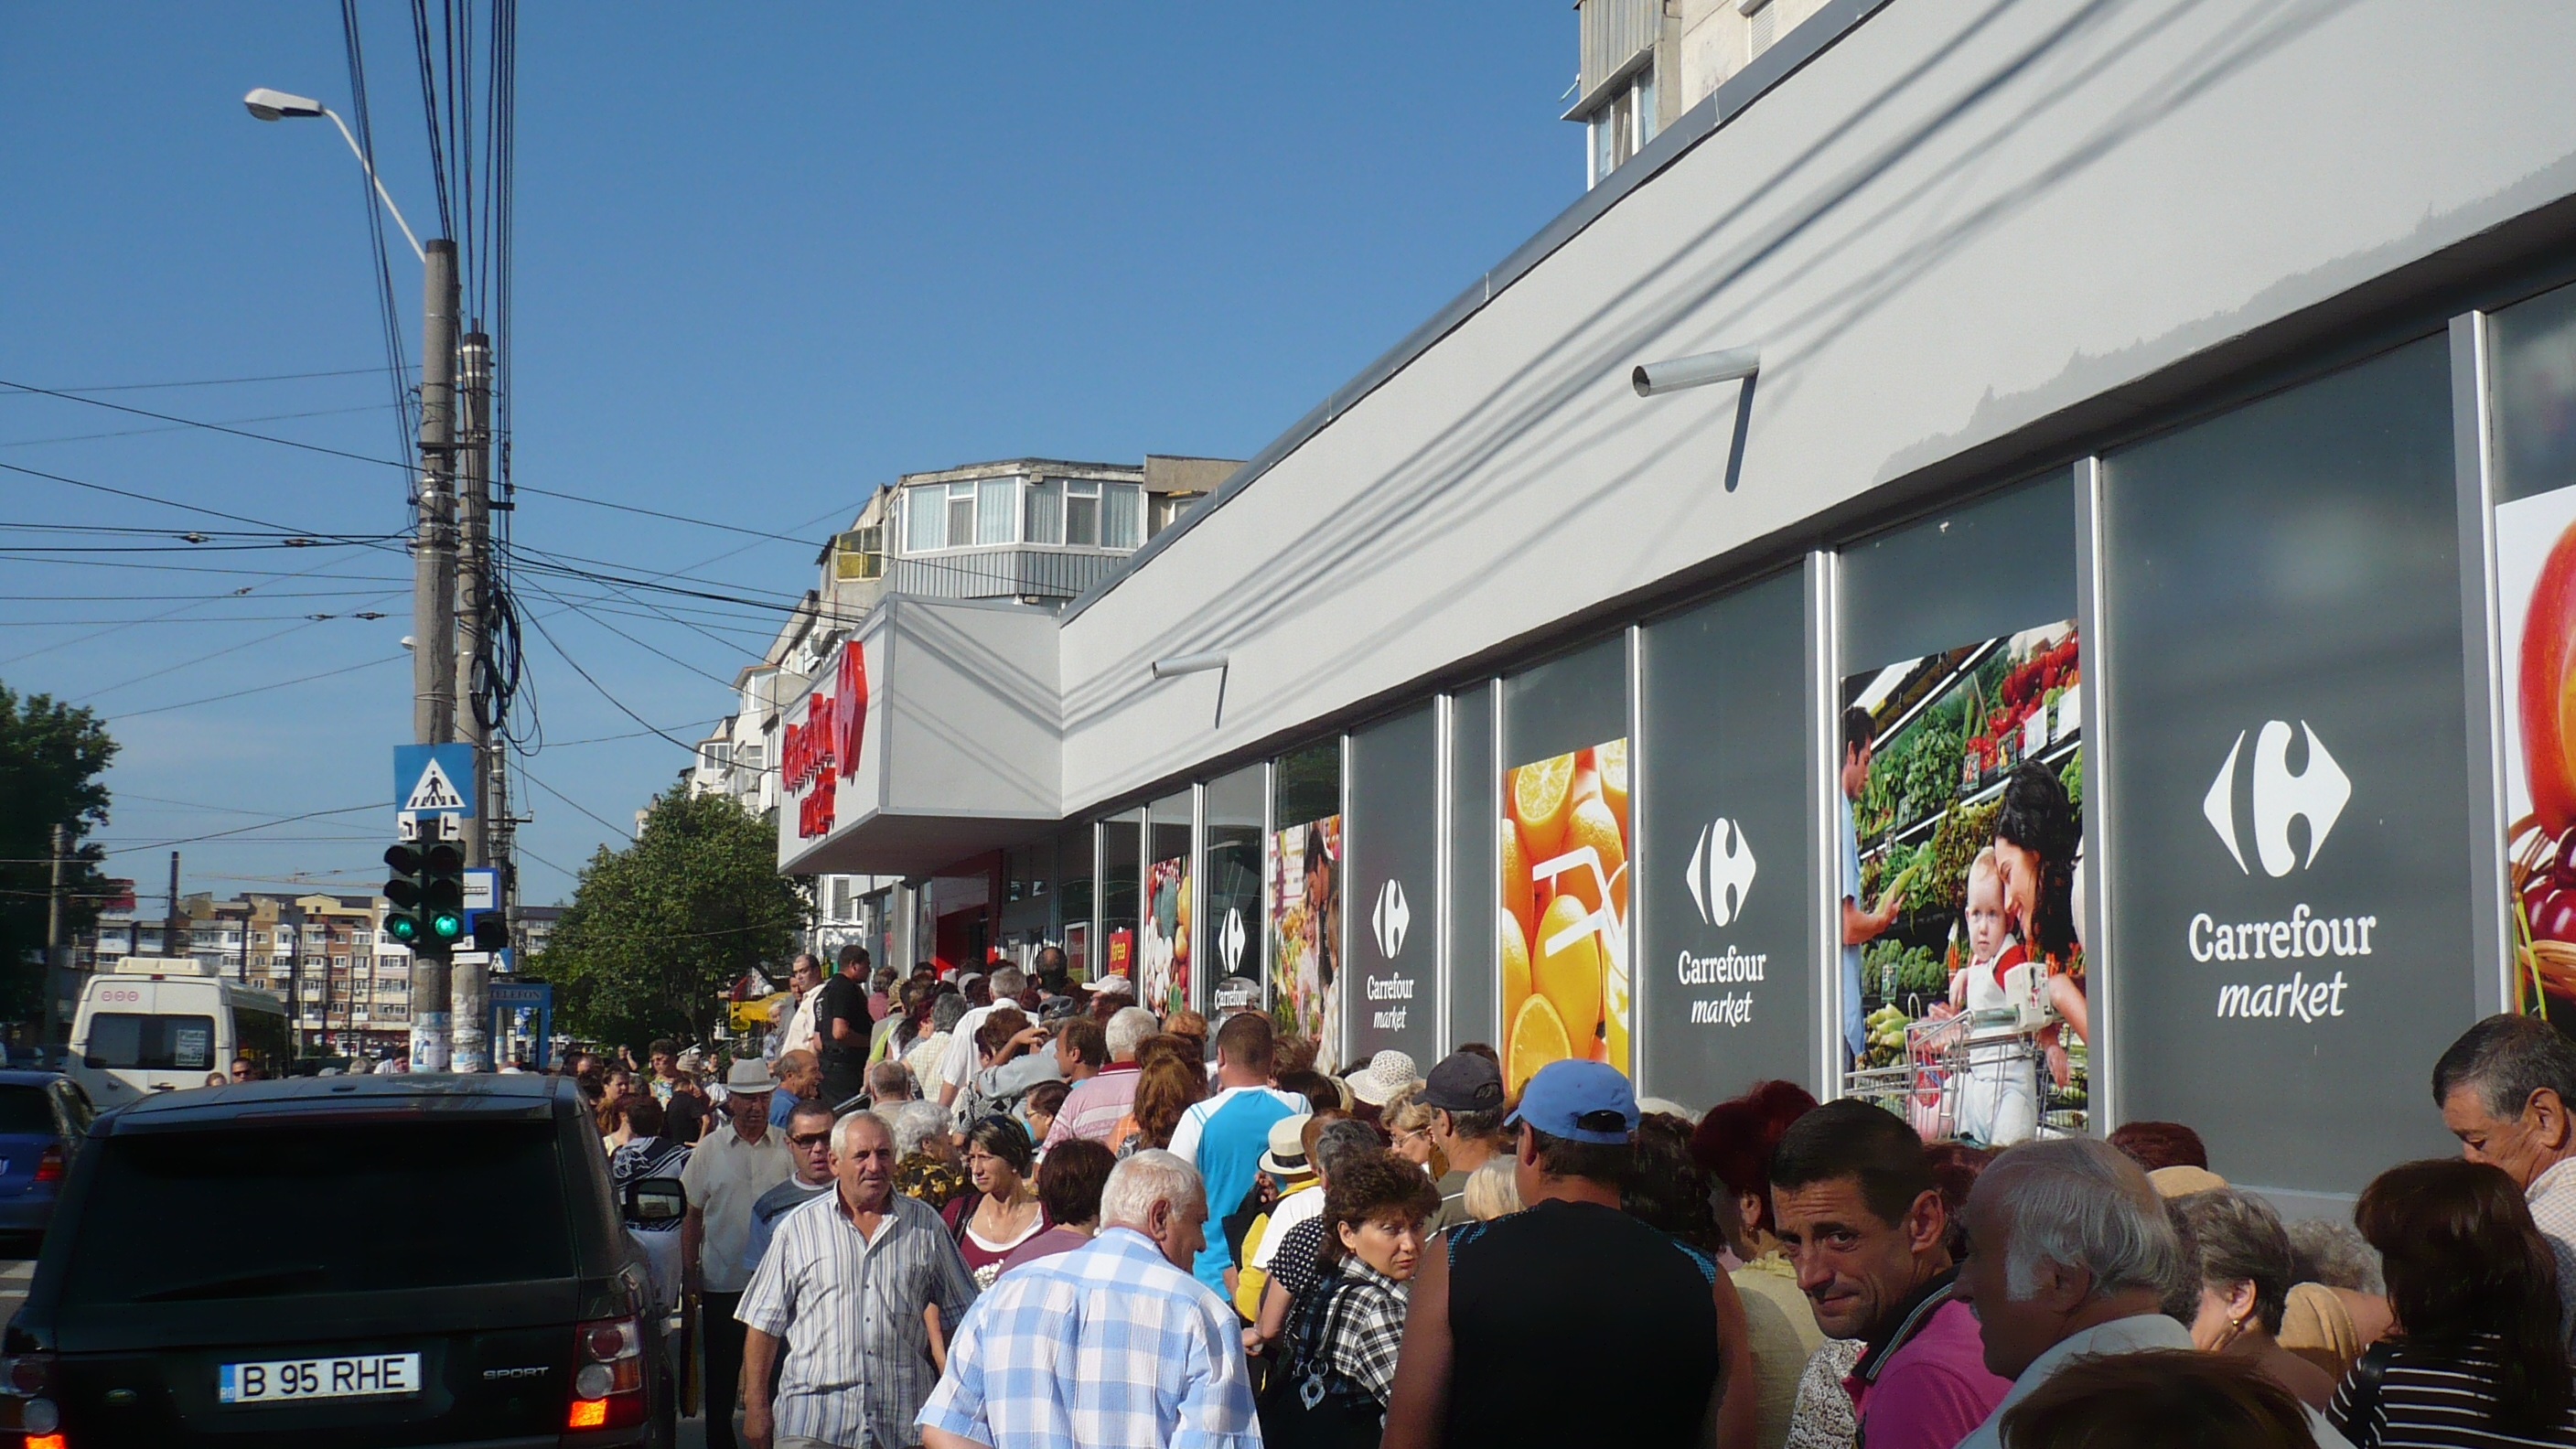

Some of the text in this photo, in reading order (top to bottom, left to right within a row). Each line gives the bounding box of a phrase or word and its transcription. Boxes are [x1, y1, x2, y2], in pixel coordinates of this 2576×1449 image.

[2188, 903, 2377, 962] Carrefour
[1678, 944, 1766, 984] Carrefour
[1214, 983, 1248, 1011] Carrefour
[1367, 971, 1414, 1001] Carrefour
[2216, 971, 2348, 1024] market
[1373, 1005, 1407, 1033] market
[1690, 991, 1754, 1027] market
[243, 1358, 405, 1397] B 95 RHE
[483, 1366, 550, 1380] SPORT
